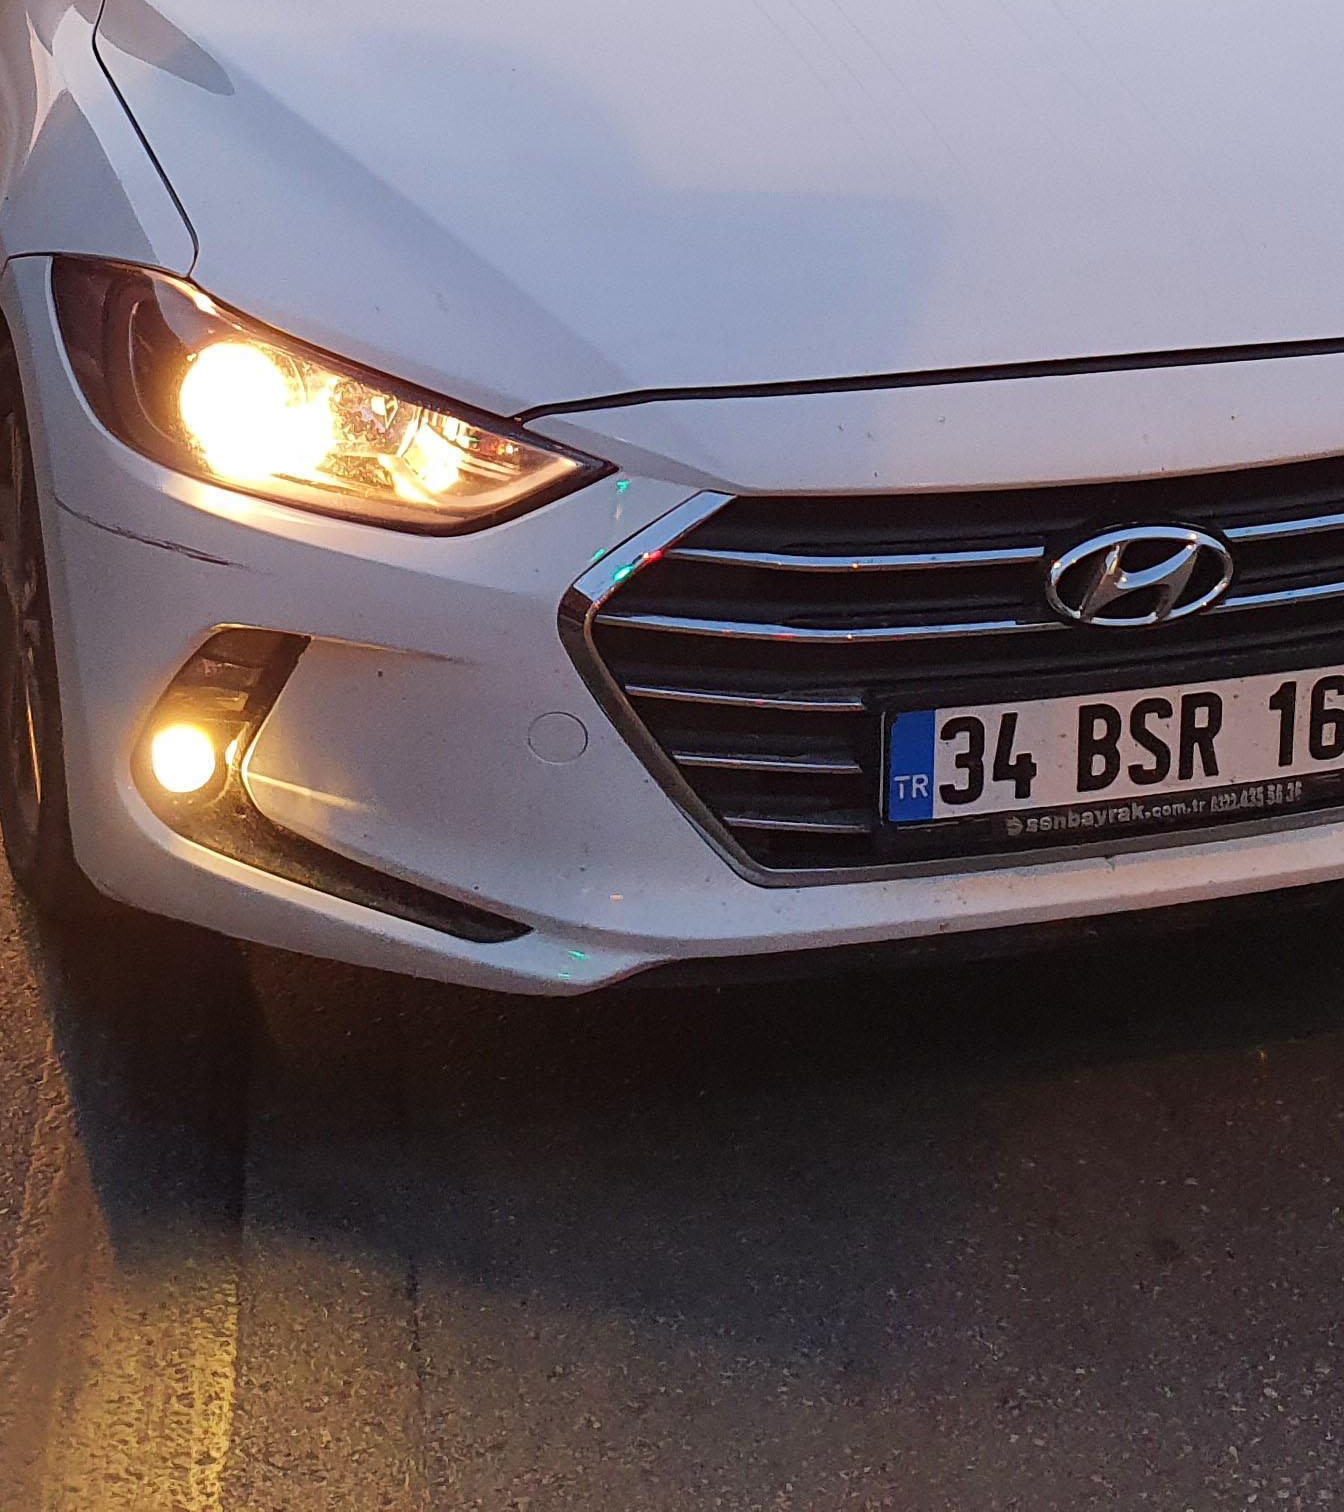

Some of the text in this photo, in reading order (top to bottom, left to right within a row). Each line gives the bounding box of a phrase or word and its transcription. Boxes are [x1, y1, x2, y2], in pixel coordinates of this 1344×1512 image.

[938, 711, 1038, 806] 34
[1076, 691, 1223, 793] BSR
[894, 773, 929, 800] TR
